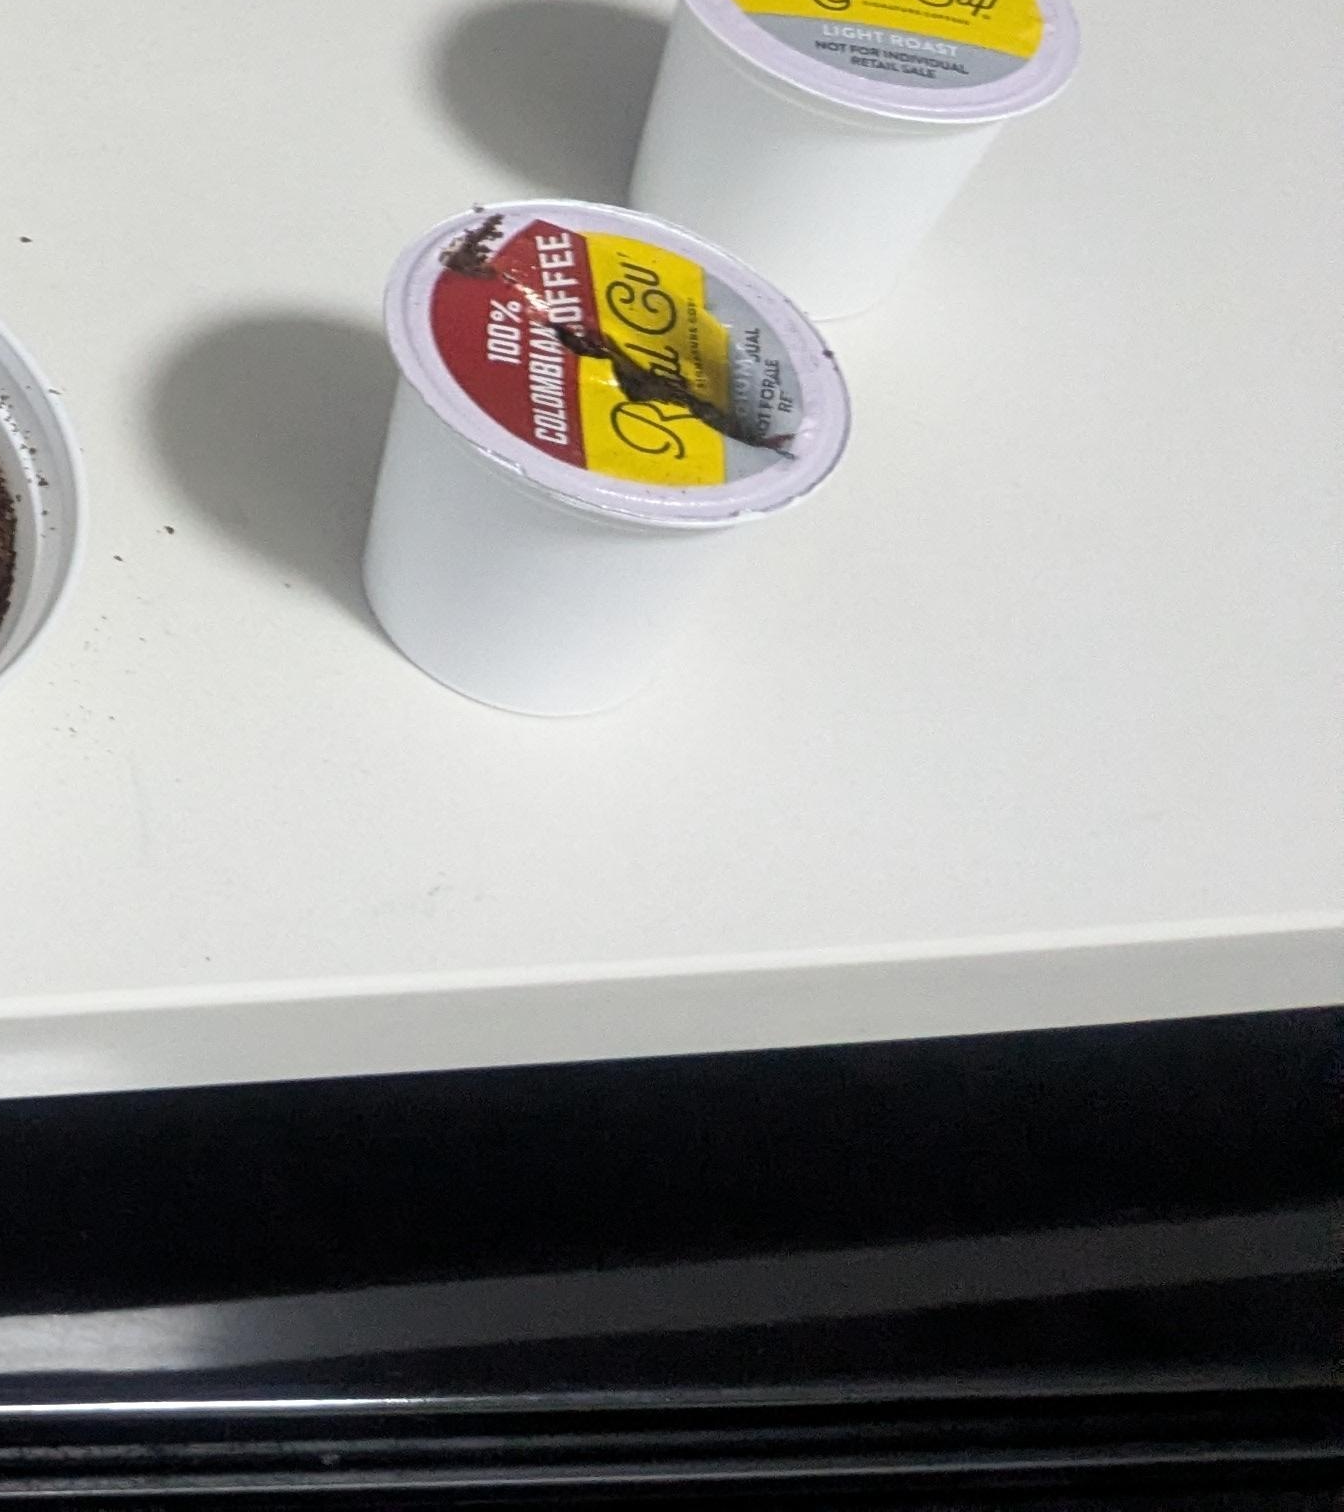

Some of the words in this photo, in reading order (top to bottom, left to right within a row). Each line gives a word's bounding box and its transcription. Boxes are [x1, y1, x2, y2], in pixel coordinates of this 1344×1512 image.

[815, 40, 848, 53] NOT
[850, 44, 880, 58] FOR
[883, 49, 969, 75] INDIVIDUAL
[822, 23, 885, 44] LIGHT
[890, 34, 959, 57] ROAST
[850, 55, 899, 72] RETAIL
[901, 64, 937, 79] SALE
[535, 232, 586, 330] OFFEE
[605, 251, 677, 336] Cu
[486, 298, 523, 366] 100%
